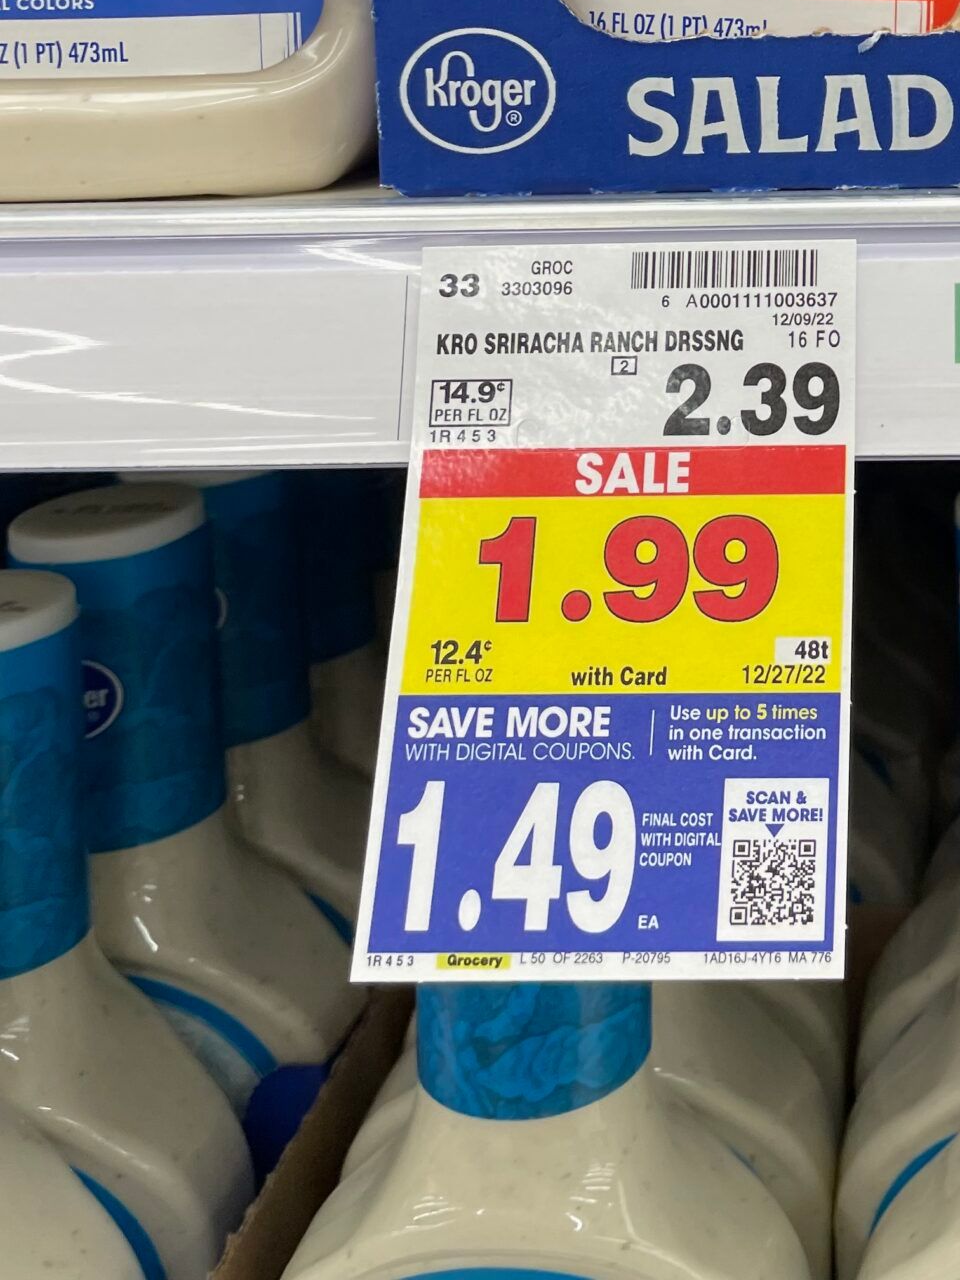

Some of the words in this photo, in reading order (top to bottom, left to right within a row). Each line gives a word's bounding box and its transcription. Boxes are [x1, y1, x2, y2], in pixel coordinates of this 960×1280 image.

[612, 12, 629, 34] FL
[634, 13, 655, 35] OZ
[69, 41, 129, 63] 473mL
[425, 50, 536, 132] Kroger
[627, 73, 954, 156] SALAD
[531, 260, 573, 275] GROC
[438, 273, 480, 298] 33
[501, 281, 573, 296] 3303096
[661, 295, 670, 308] 6
[772, 312, 834, 327] 12/09/22
[436, 332, 478, 355] KRO
[484, 331, 584, 355] SRIRACHA
[590, 330, 658, 353] RANCH
[664, 329, 744, 352] DRSSNG
[788, 330, 808, 348] 16
[816, 329, 840, 348] FO
[663, 361, 841, 437] 2.39
[434, 408, 462, 422] PER
[468, 408, 483, 421] FL
[489, 407, 507, 421] OZ
[575, 452, 690, 495] SALE
[478, 514, 779, 623] 1.99
[794, 640, 829, 659] 48t
[425, 668, 451, 682] PER
[456, 668, 471, 682] FL
[475, 668, 493, 682] OZ
[571, 666, 613, 686] with
[620, 666, 667, 686] Card
[742, 664, 826, 684] 12/27/22
[407, 706, 495, 739] SAVE
[506, 705, 611, 738] MORE
[670, 705, 701, 720] Use
[706, 707, 729, 723] up
[734, 705, 751, 720] to
[756, 704, 767, 720] 5
[772, 704, 818, 720] times
[668, 725, 684, 740] in
[689, 726, 723, 740] one
[728, 724, 826, 740] transaction
[405, 743, 450, 761] WITH
[456, 742, 527, 761] DIGITAL
[532, 742, 636, 761] COUPONS.
[668, 745, 702, 760] with
[708, 744, 757, 761] Card.
[746, 790, 792, 805] SCAN
[796, 790, 807, 805] &
[641, 812, 677, 827] FINAL
[680, 812, 713, 826] COST
[728, 808, 766, 822] SAVE
[772, 808, 823, 822] MORE!
[641, 832, 672, 847] WITH
[674, 832, 721, 847] DIGITAL
[397, 780, 636, 933] 1.49
[639, 852, 692, 867] COUPON
[637, 915, 659, 929] EA
[447, 953, 502, 968] Grocery
[530, 952, 546, 964] 50
[552, 951, 570, 963] OF
[574, 951, 603, 964] 2263
[622, 951, 671, 964] P-20795
[811, 951, 832, 963] 776
